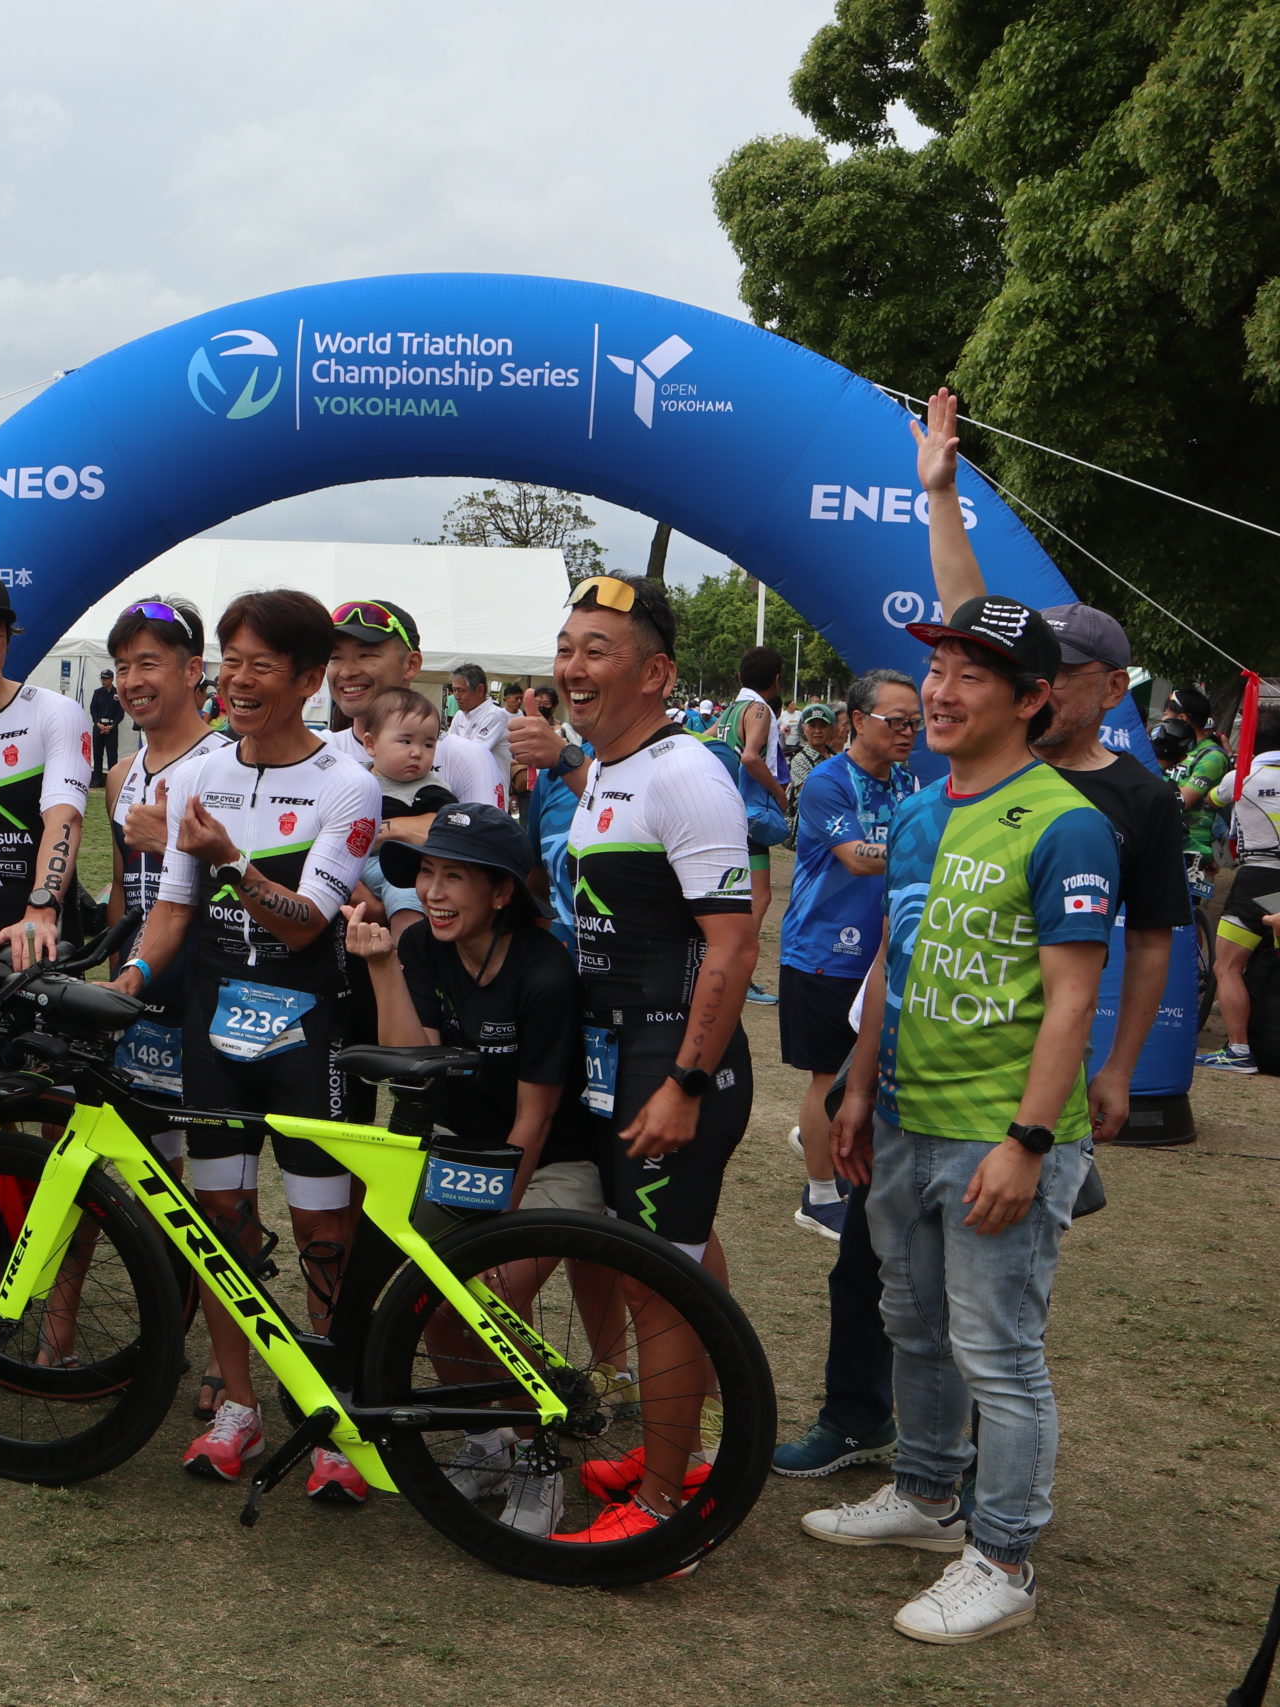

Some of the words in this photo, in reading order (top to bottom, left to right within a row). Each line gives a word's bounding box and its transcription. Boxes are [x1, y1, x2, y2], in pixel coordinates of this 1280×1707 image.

[314, 332, 393, 355] World
[397, 333, 513, 357] Triathlon
[311, 359, 495, 391] Championship
[500, 361, 579, 388] Series
[661, 383, 697, 396] OPEN
[314, 396, 459, 417] YOKOHAMA
[661, 400, 734, 412] YOKOHAMA
[220, 795, 241, 804] CYCLE
[269, 796, 317, 807] TREK
[601, 791, 635, 802] TREK
[42, 824, 71, 892] 1408
[941, 852, 1006, 894] TRIP
[1063, 873, 1111, 895] YOKOSUKA
[1193, 881, 1212, 894] 2361
[928, 897, 1034, 946] CYCLE
[920, 938, 1020, 987] TRIAT
[908, 982, 1016, 1027] HLON
[226, 1006, 289, 1037] 2236
[127, 1041, 174, 1068] 1486
[439, 1167, 505, 1196] 2236
[441, 1192, 457, 1201] 2024
[457, 1194, 496, 1205] YOKOHAMA
[138, 1160, 292, 1351] TREK
[487, 1295, 558, 1361] TREK
[478, 1313, 548, 1397] TREK
